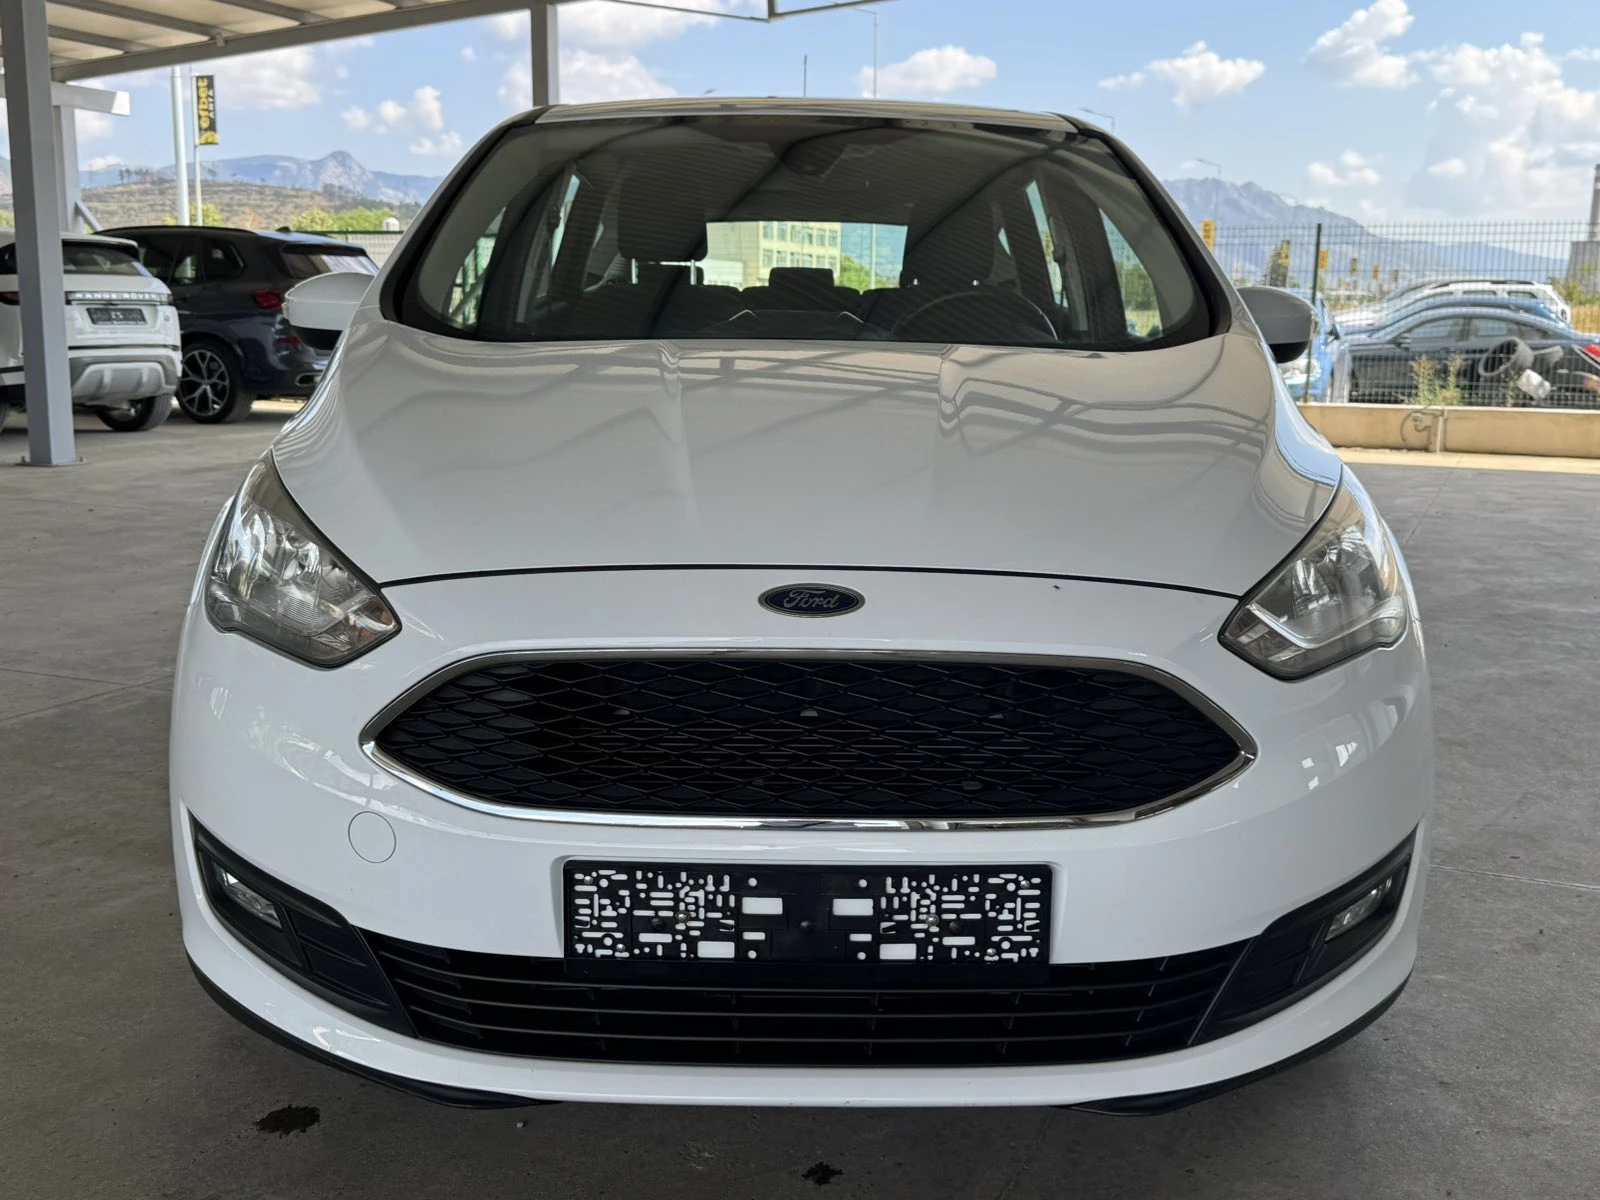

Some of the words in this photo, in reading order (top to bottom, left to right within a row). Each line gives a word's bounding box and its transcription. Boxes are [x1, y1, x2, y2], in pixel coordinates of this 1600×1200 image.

[197, 78, 210, 129] efbet
[75, 292, 118, 300] RANGE
[783, 589, 840, 609] Ford
